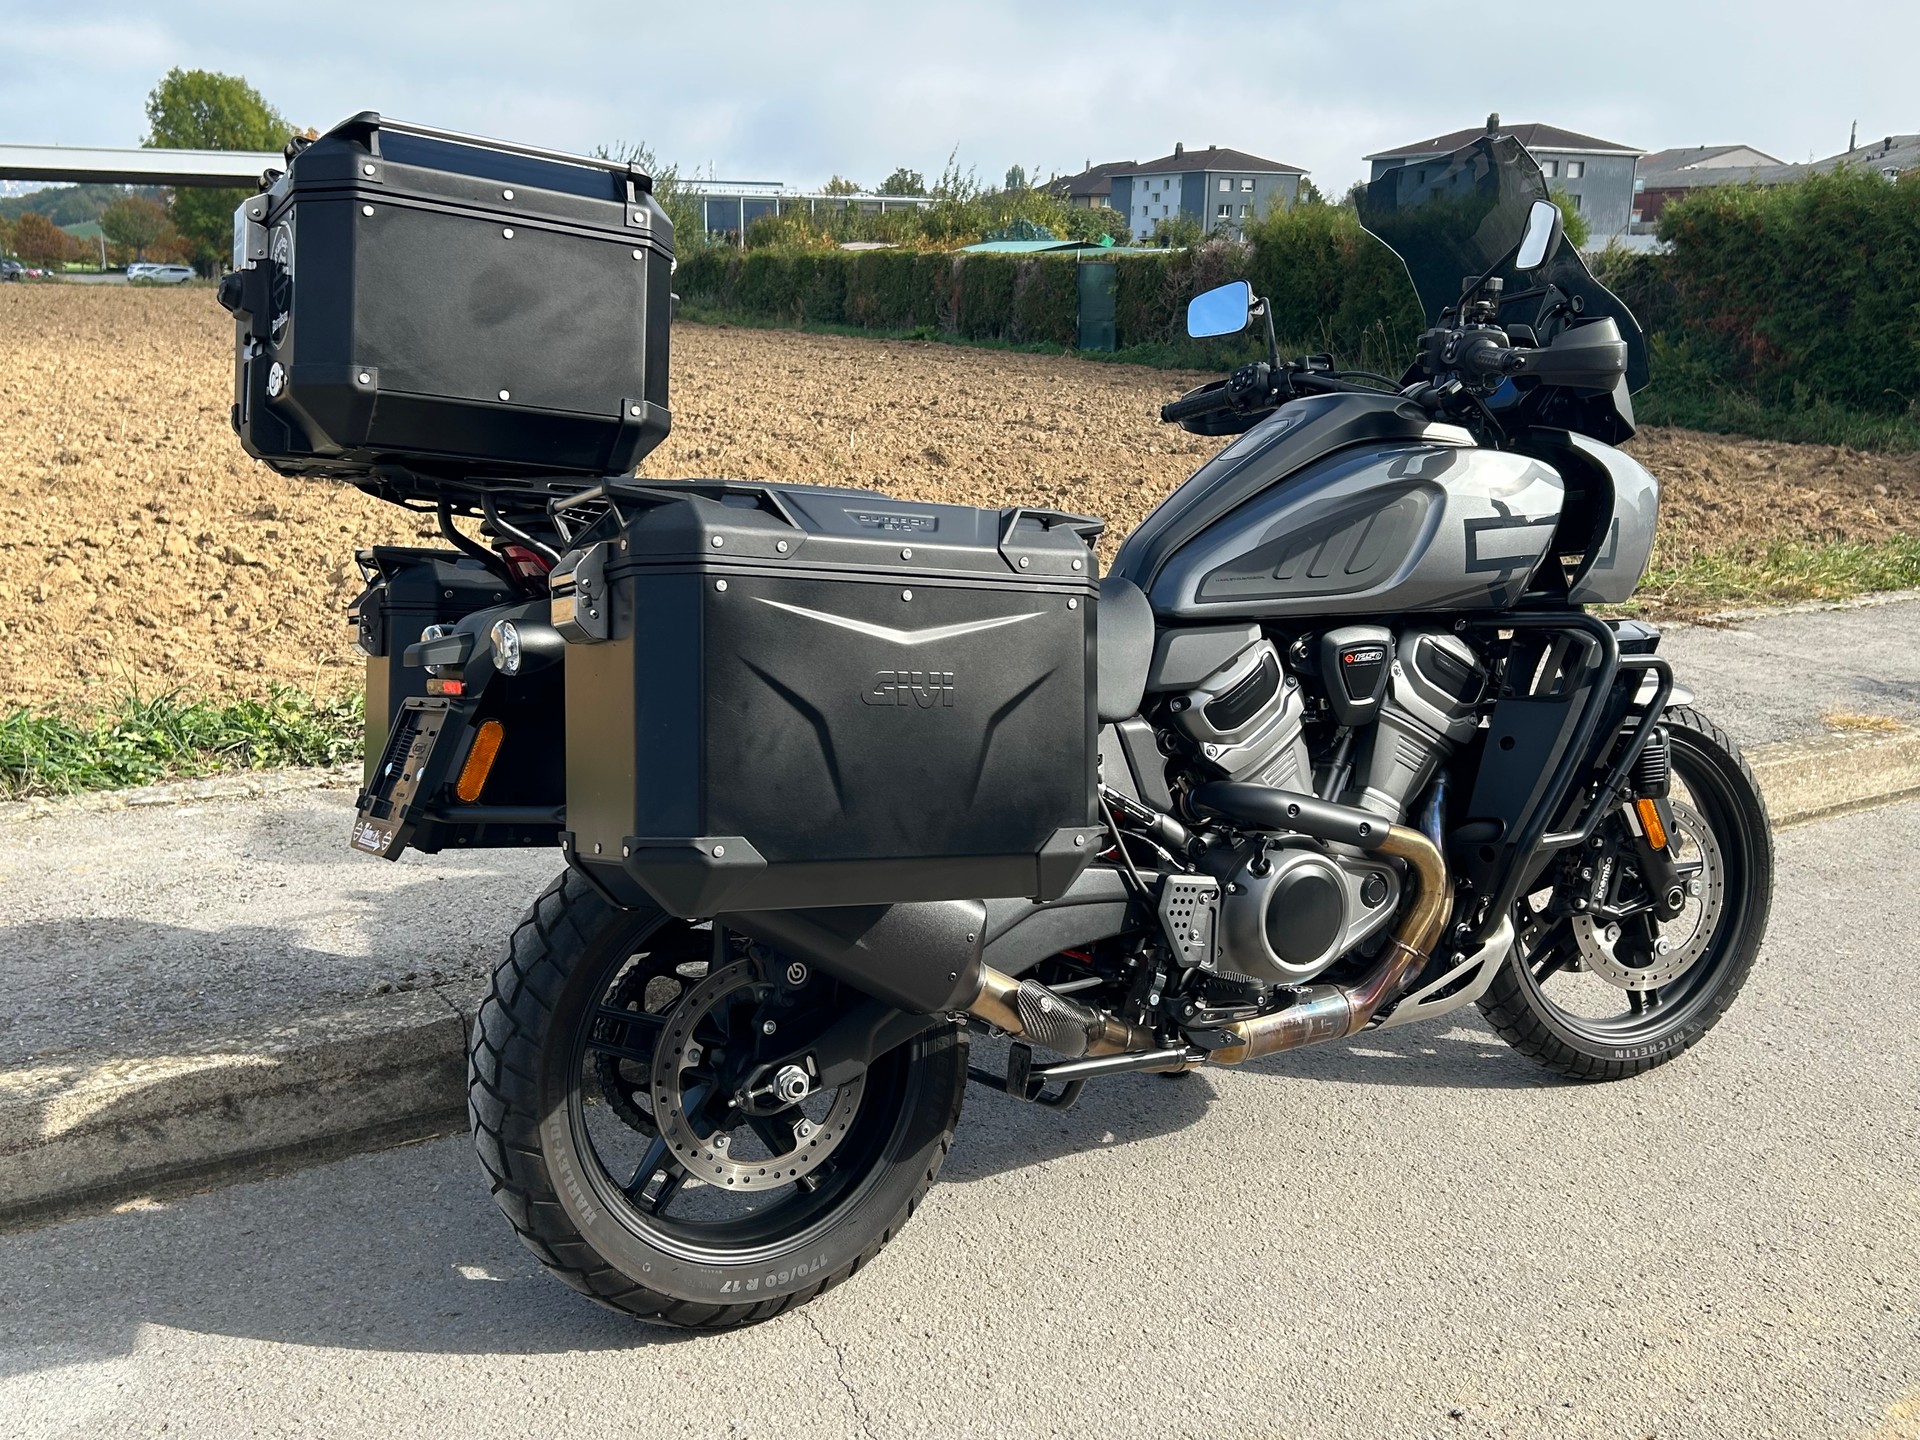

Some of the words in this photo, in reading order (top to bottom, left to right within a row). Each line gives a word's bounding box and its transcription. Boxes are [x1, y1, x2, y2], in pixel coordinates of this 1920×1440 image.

[860, 669, 954, 710] GIVI
[1594, 856, 1613, 899] brembo
[1614, 1030, 1685, 1058] MICHELIN
[745, 1277, 759, 1288] R
[765, 1253, 828, 1288] 170/60
[719, 1280, 741, 1293] 17
